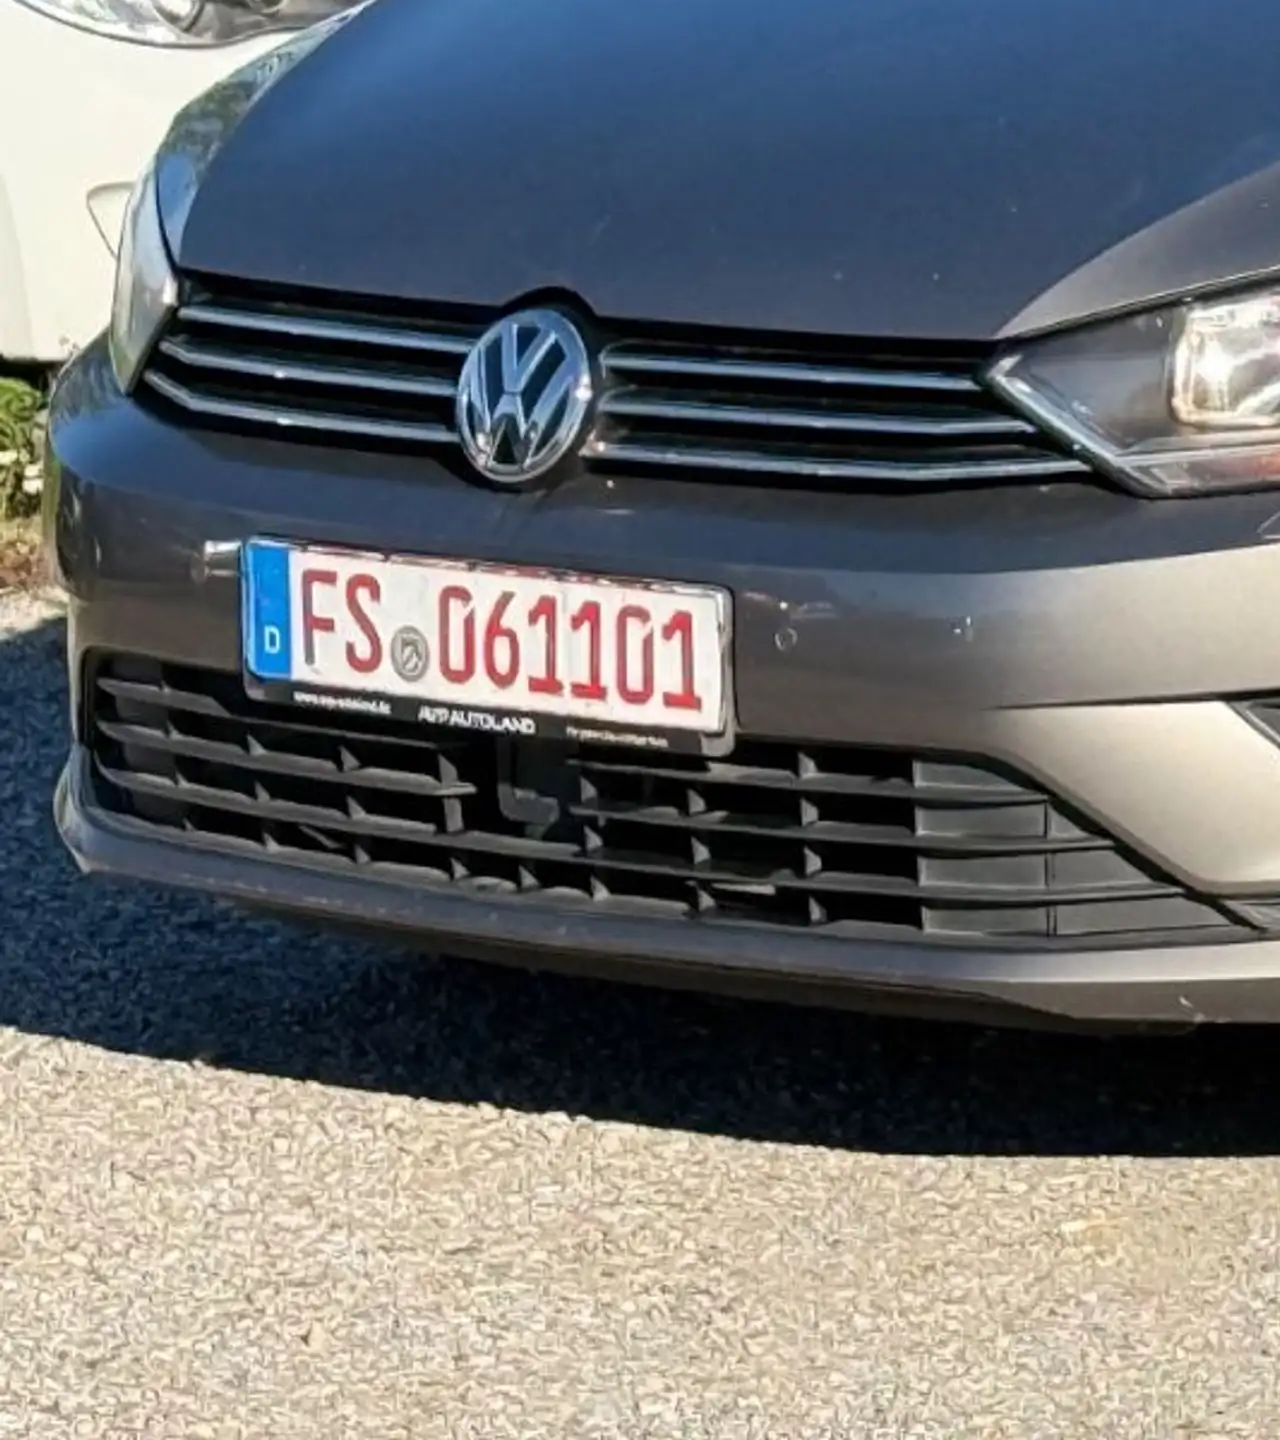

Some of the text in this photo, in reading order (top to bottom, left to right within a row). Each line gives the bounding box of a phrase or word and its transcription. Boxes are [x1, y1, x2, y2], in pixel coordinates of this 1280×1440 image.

[458, 310, 591, 482] VW
[264, 626, 280, 655] D
[301, 570, 702, 711] FS 061101
